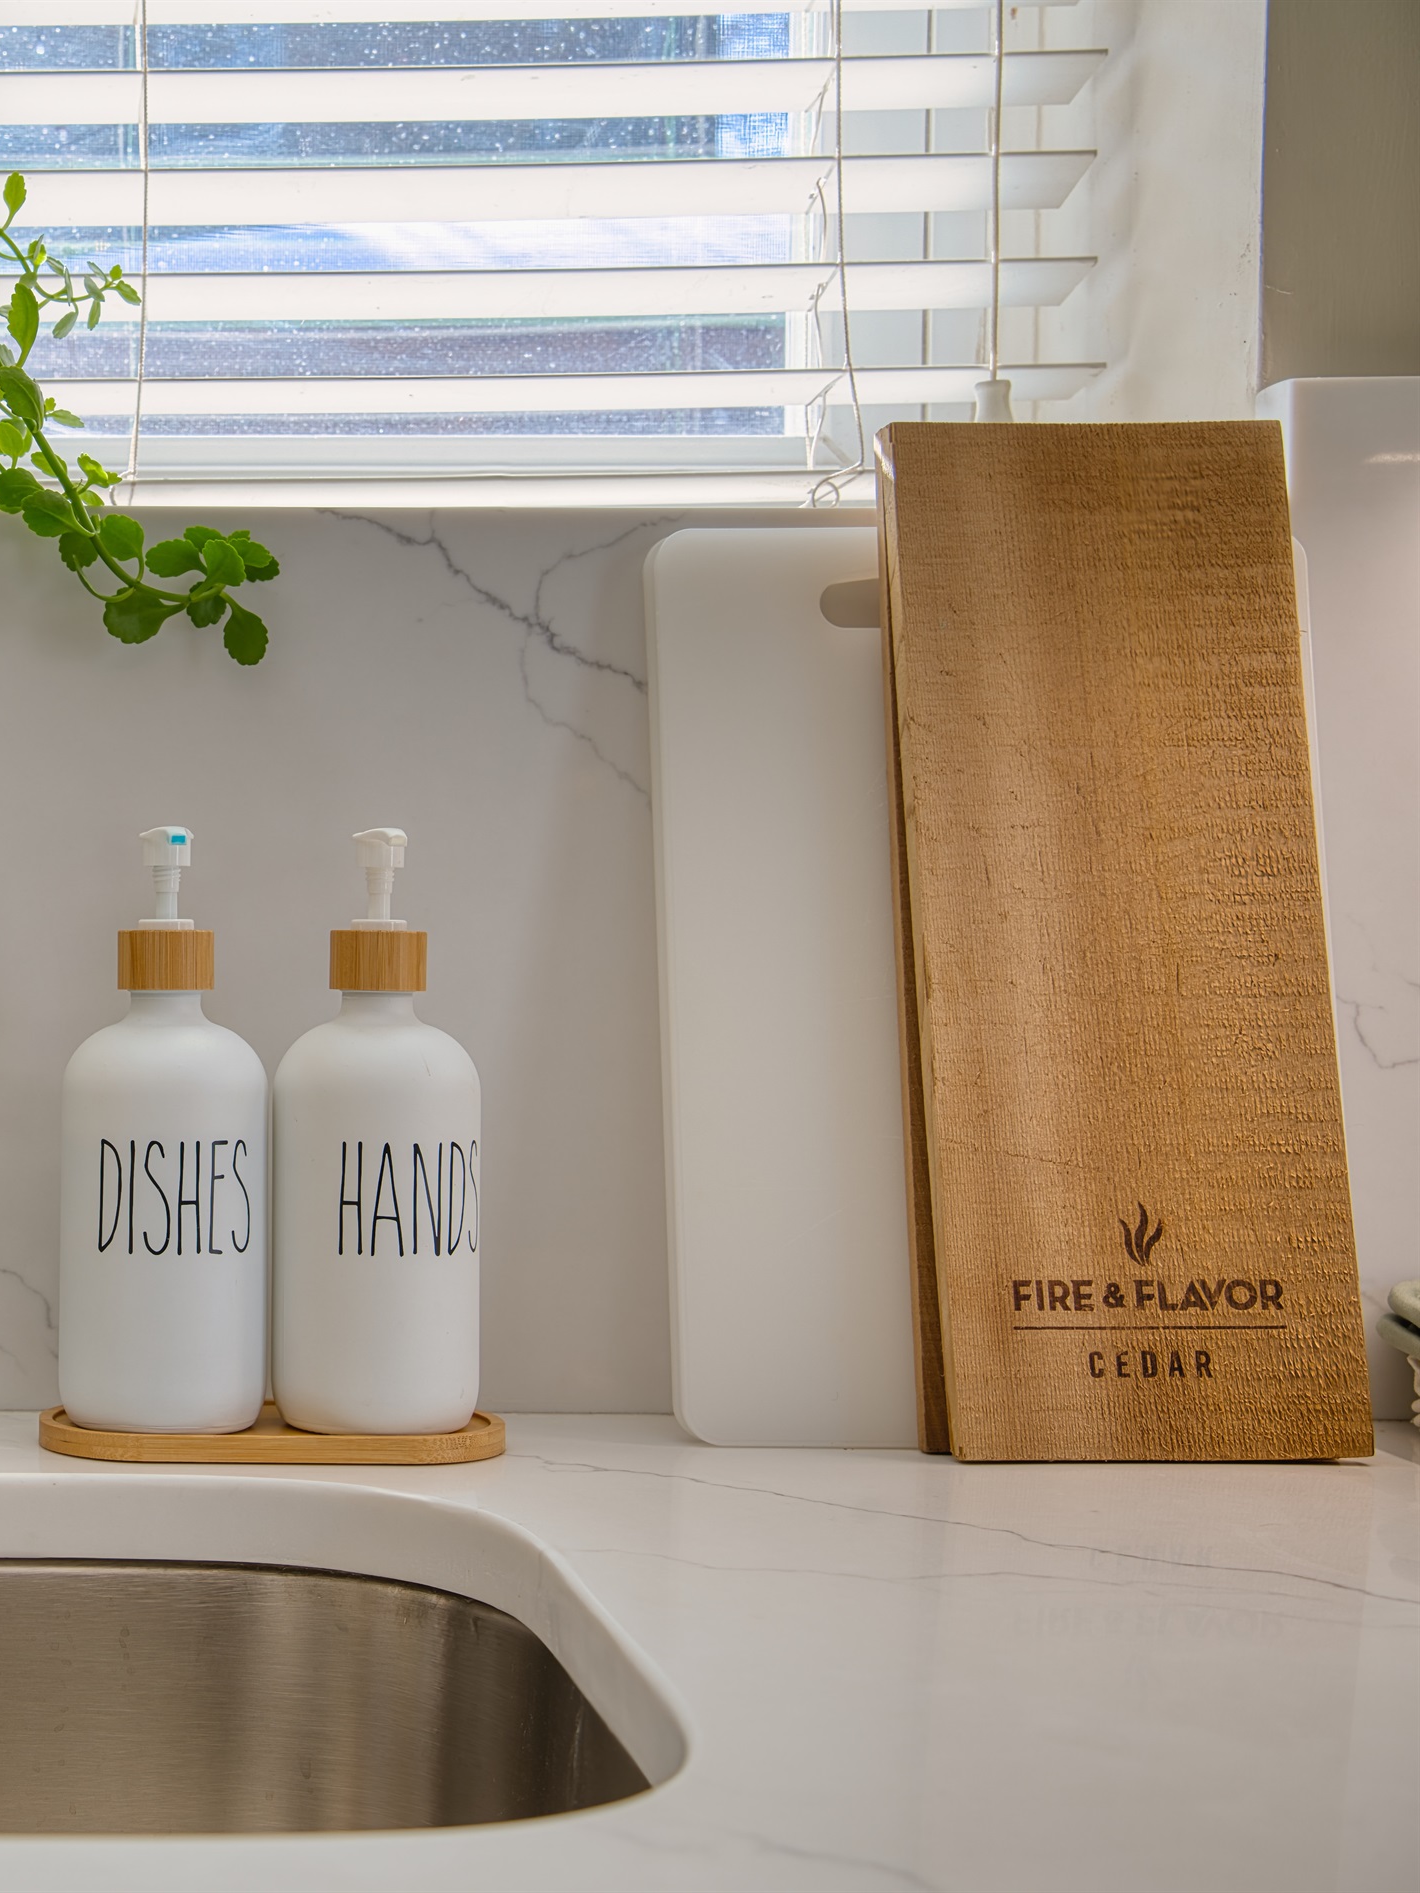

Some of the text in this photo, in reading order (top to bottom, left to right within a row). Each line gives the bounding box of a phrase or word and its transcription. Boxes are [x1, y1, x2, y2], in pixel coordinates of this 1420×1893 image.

[97, 1138, 251, 1256] DISHES
[338, 1139, 478, 1257] HANDS
[1012, 1278, 1284, 1311] FIRE & FLAVOR
[1088, 1350, 1214, 1378] CEDAR
